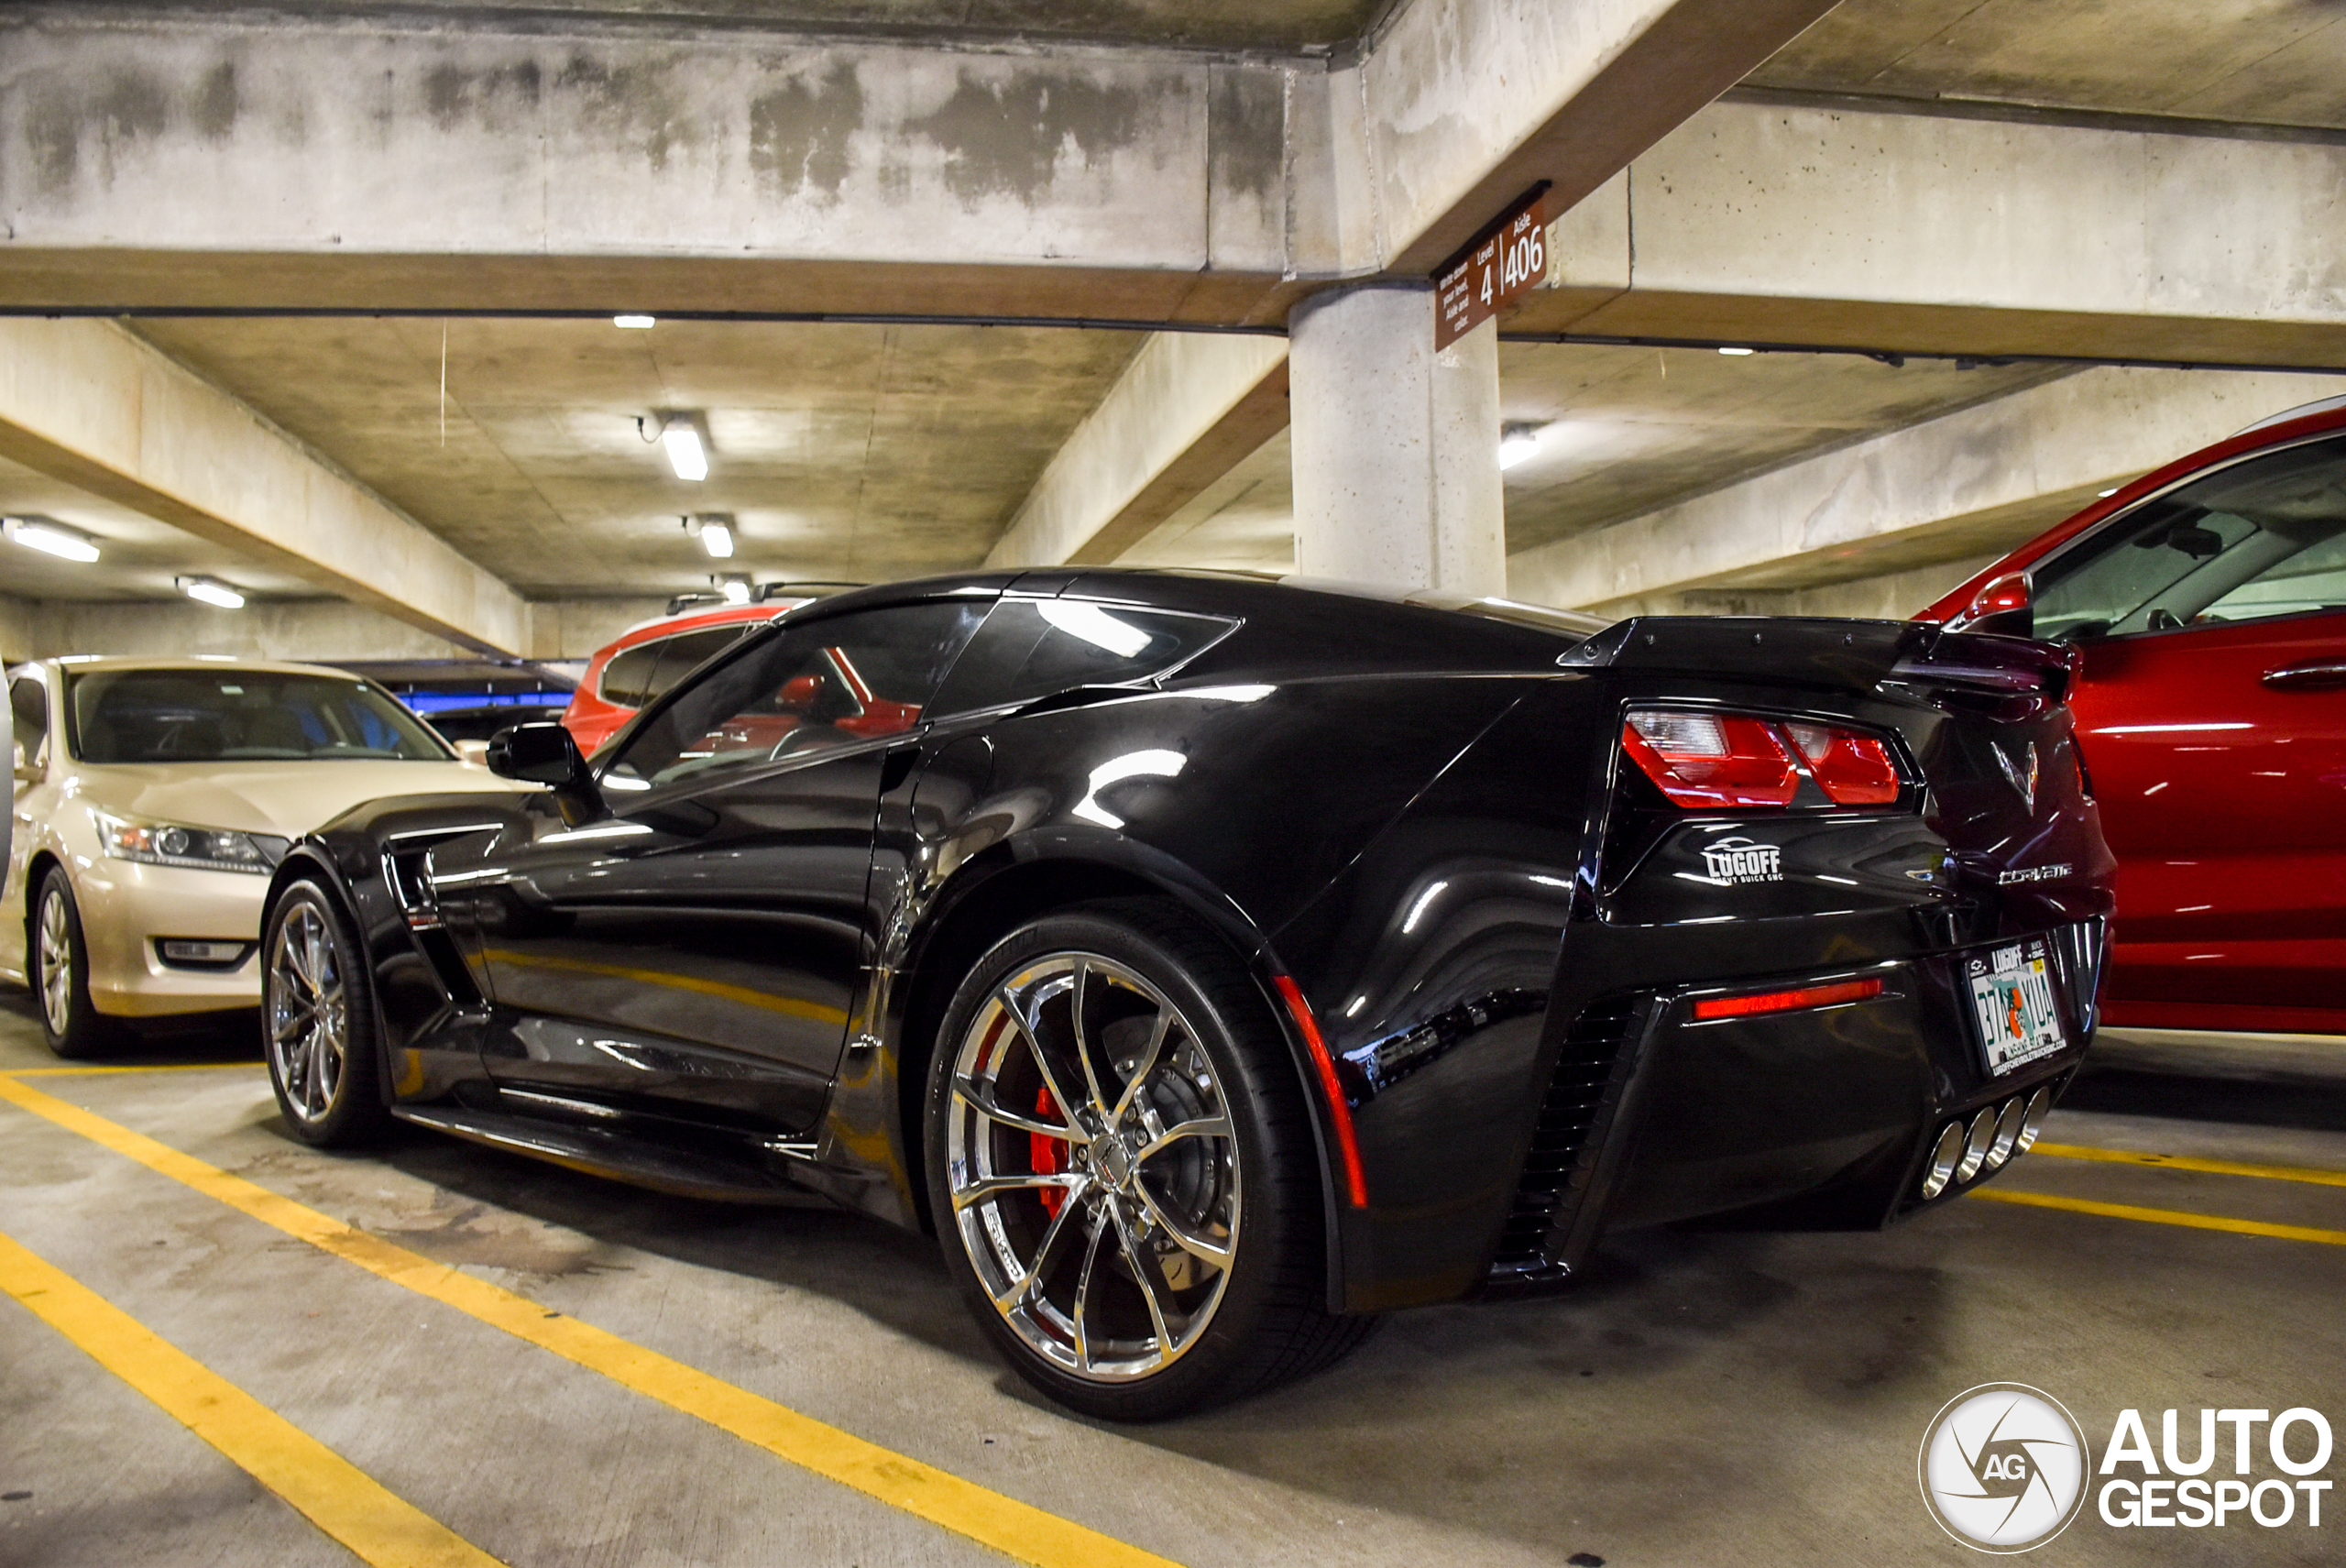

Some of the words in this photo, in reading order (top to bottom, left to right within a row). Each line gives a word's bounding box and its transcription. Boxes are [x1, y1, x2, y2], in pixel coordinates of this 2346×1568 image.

[1513, 212, 1531, 237] Aisle
[1476, 238, 1495, 267] Level
[1505, 225, 1543, 288] 406
[1480, 264, 1494, 306] 4
[1706, 850, 1781, 877] LUGOFF
[1712, 876, 1738, 884] HEVY
[1740, 874, 1765, 883] BUICK
[1767, 873, 1783, 882] GMC
[1991, 943, 2023, 974] LUGOFF
